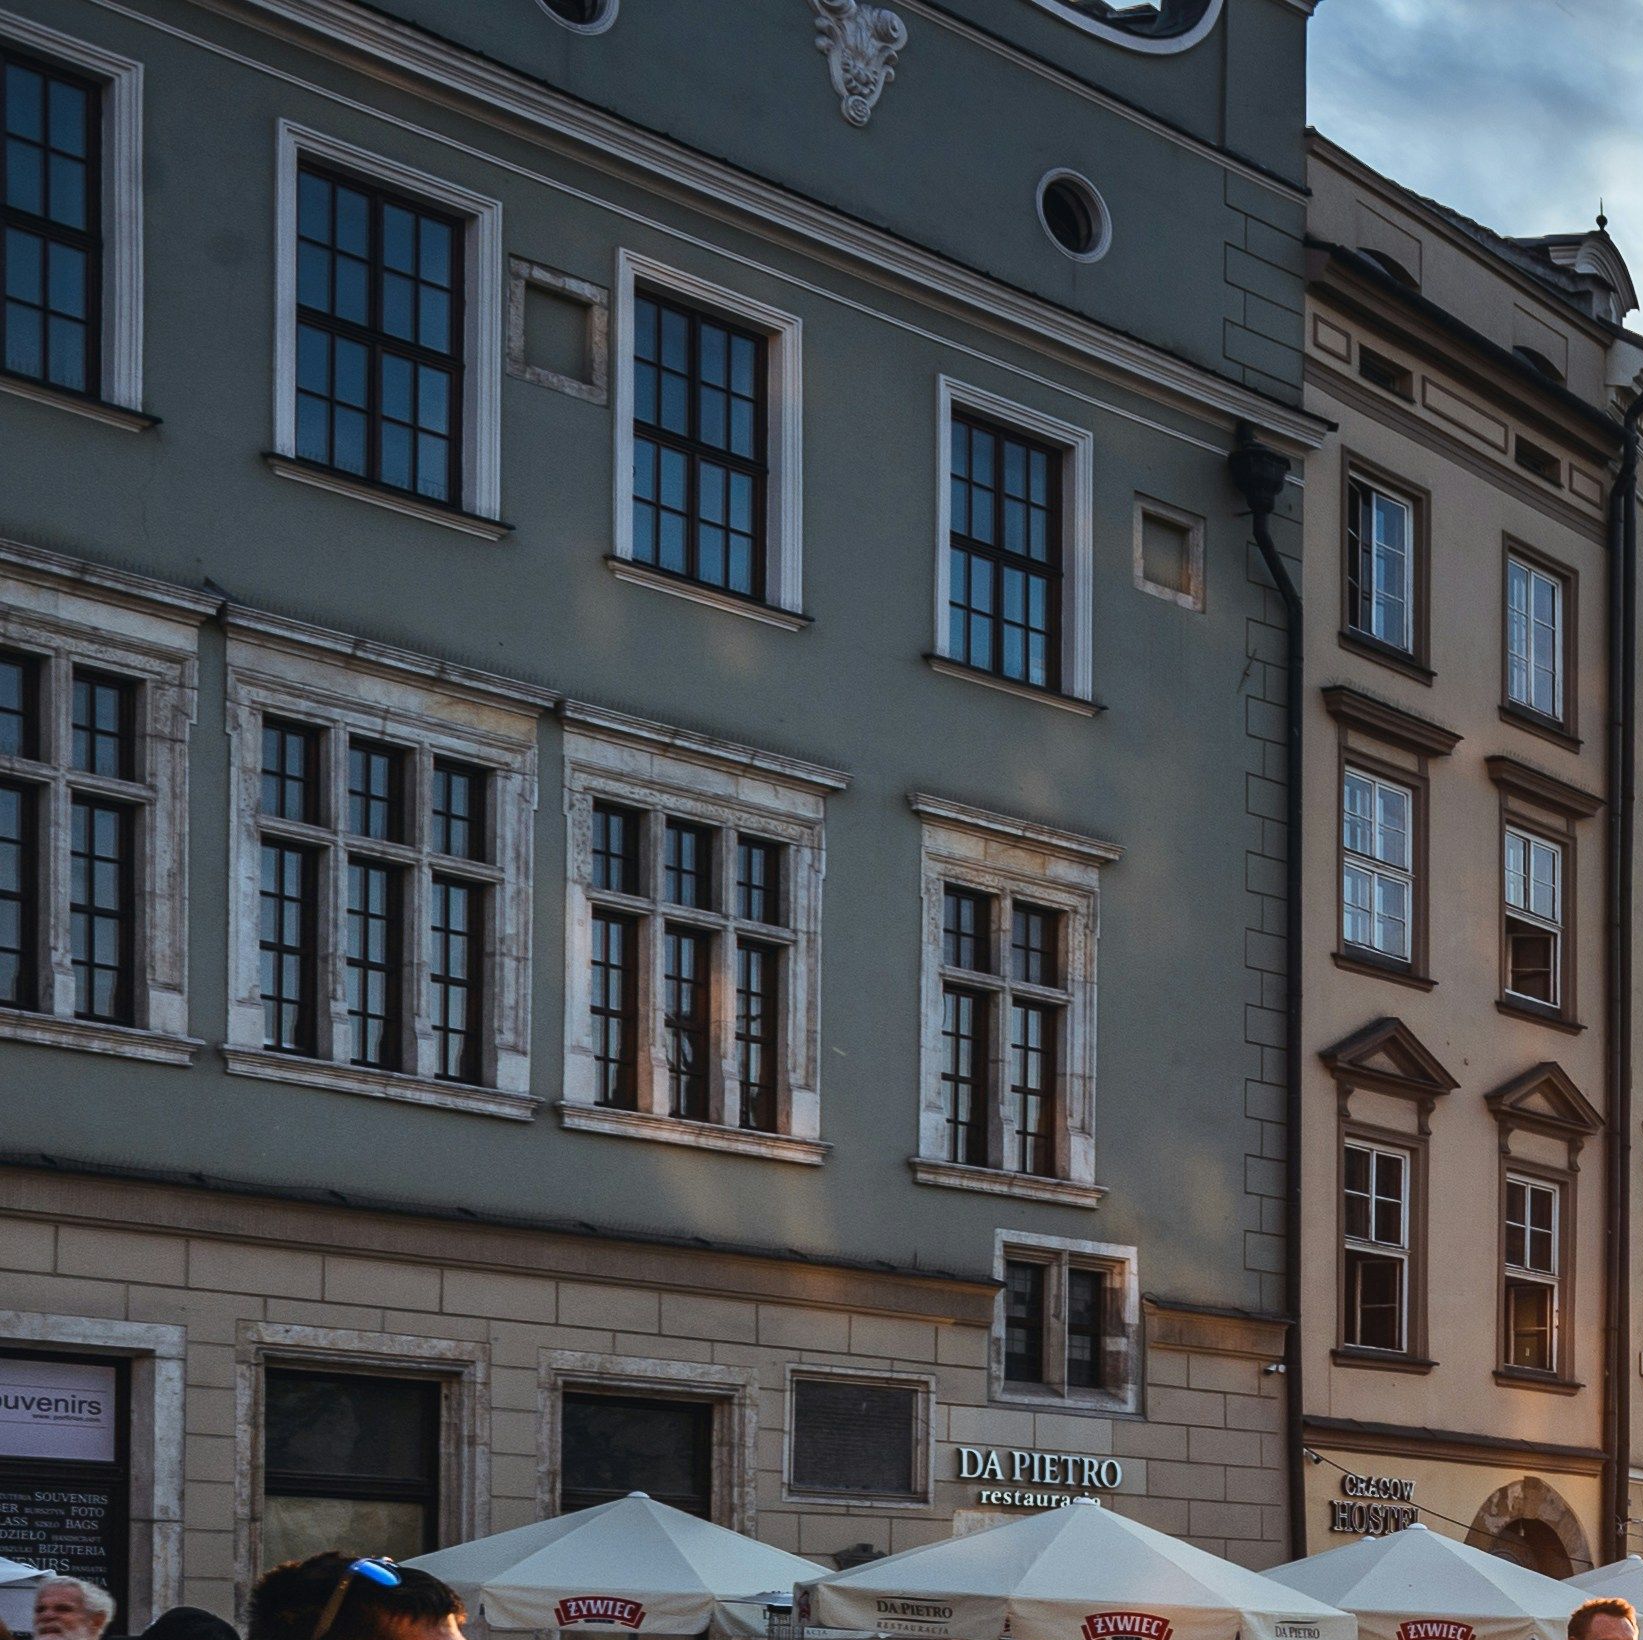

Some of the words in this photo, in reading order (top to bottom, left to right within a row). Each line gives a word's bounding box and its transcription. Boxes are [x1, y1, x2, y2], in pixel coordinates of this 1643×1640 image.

[0, 1394, 103, 1415] uvenirs
[959, 1447, 1005, 1480] DA
[1011, 1450, 1123, 1489] PIETRO
[1344, 1474, 1417, 1500] CRACOW
[34, 1491, 108, 1505] SOUVENIRS
[980, 1490, 1101, 1508] restauraa
[71, 1506, 105, 1518] FOTO
[66, 1519, 99, 1530] BAGS
[567, 1599, 635, 1619] ŻYWIEC
[876, 1600, 898, 1615] DA
[900, 1602, 953, 1619] PIETRO
[1094, 1615, 1162, 1636] ŻYWIEC
[1289, 1626, 1320, 1639] PIETRO
[1407, 1622, 1467, 1640] ŻYWIEC
